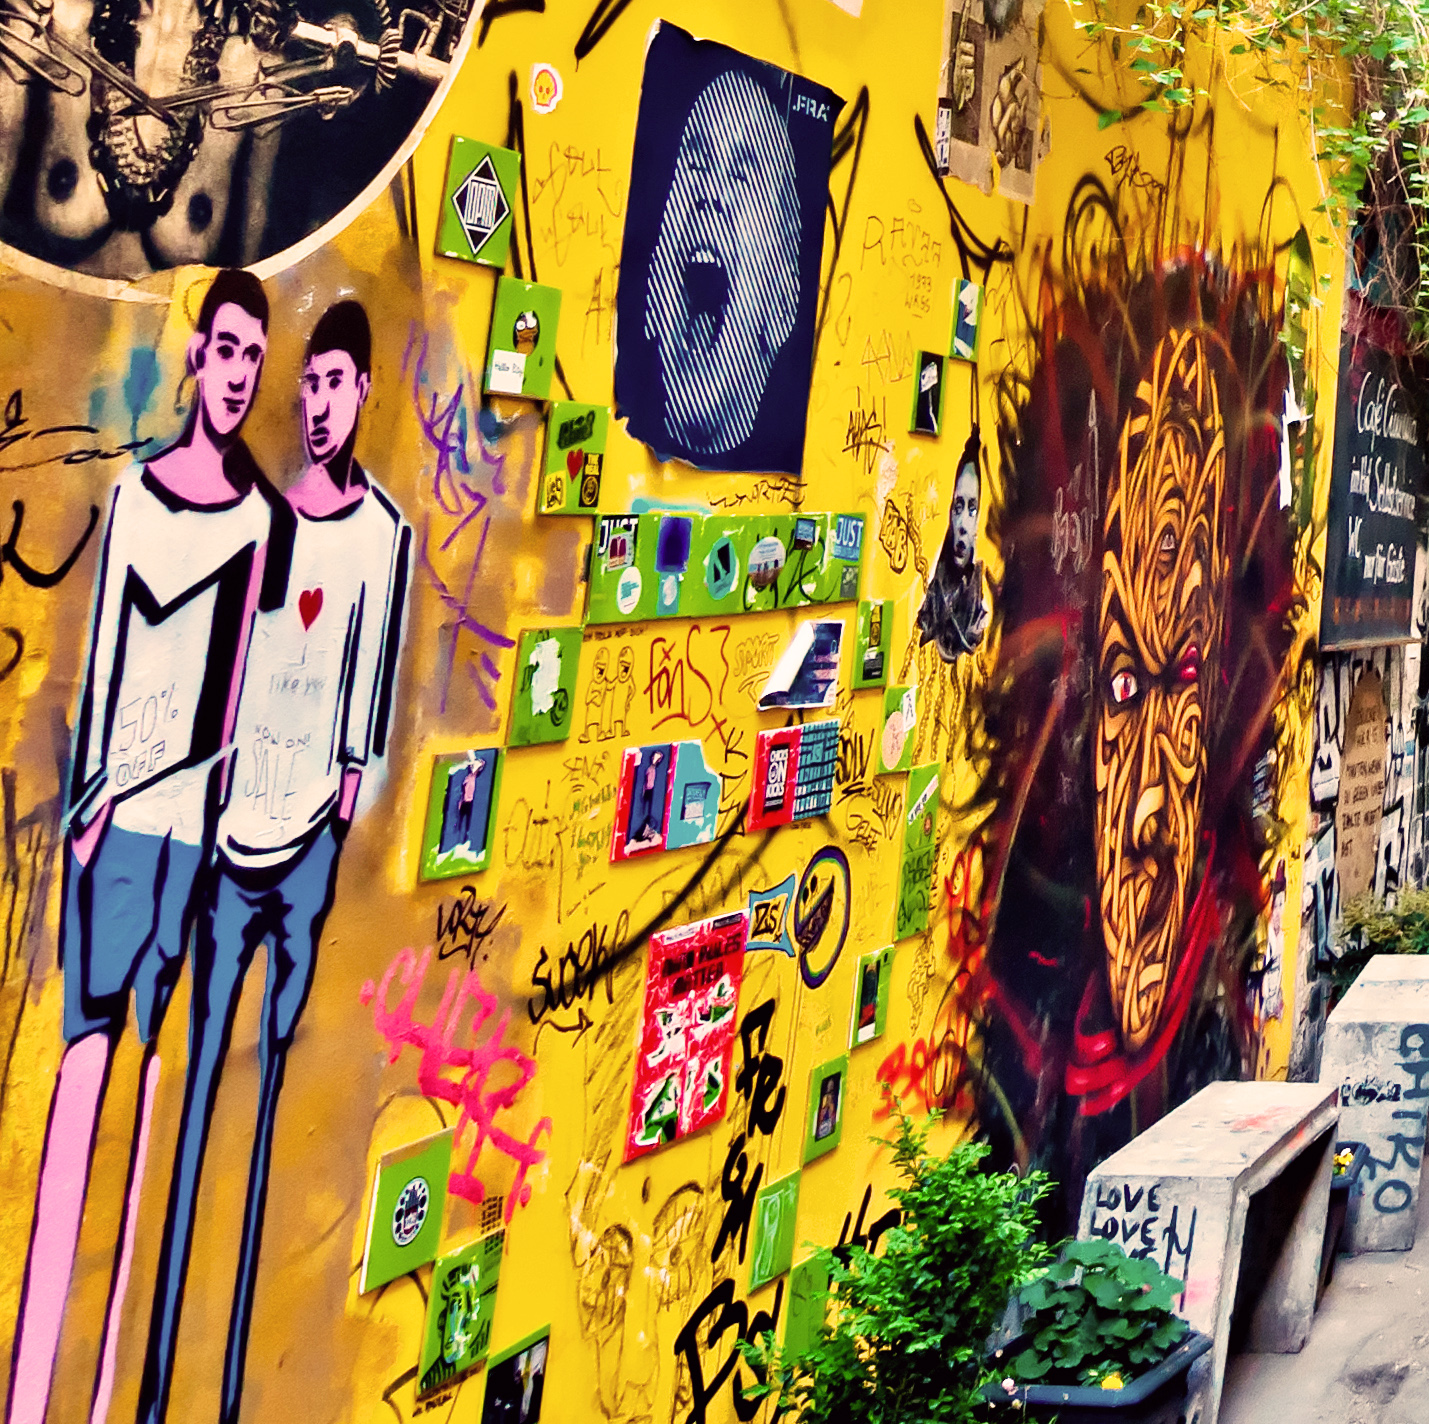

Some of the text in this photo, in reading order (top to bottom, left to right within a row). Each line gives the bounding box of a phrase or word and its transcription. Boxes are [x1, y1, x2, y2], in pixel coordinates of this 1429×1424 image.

[118, 681, 179, 752] 50%
[115, 739, 166, 787] OFF
[1095, 1180, 1162, 1213] LOVE
[1090, 1209, 1159, 1247] LOVE
